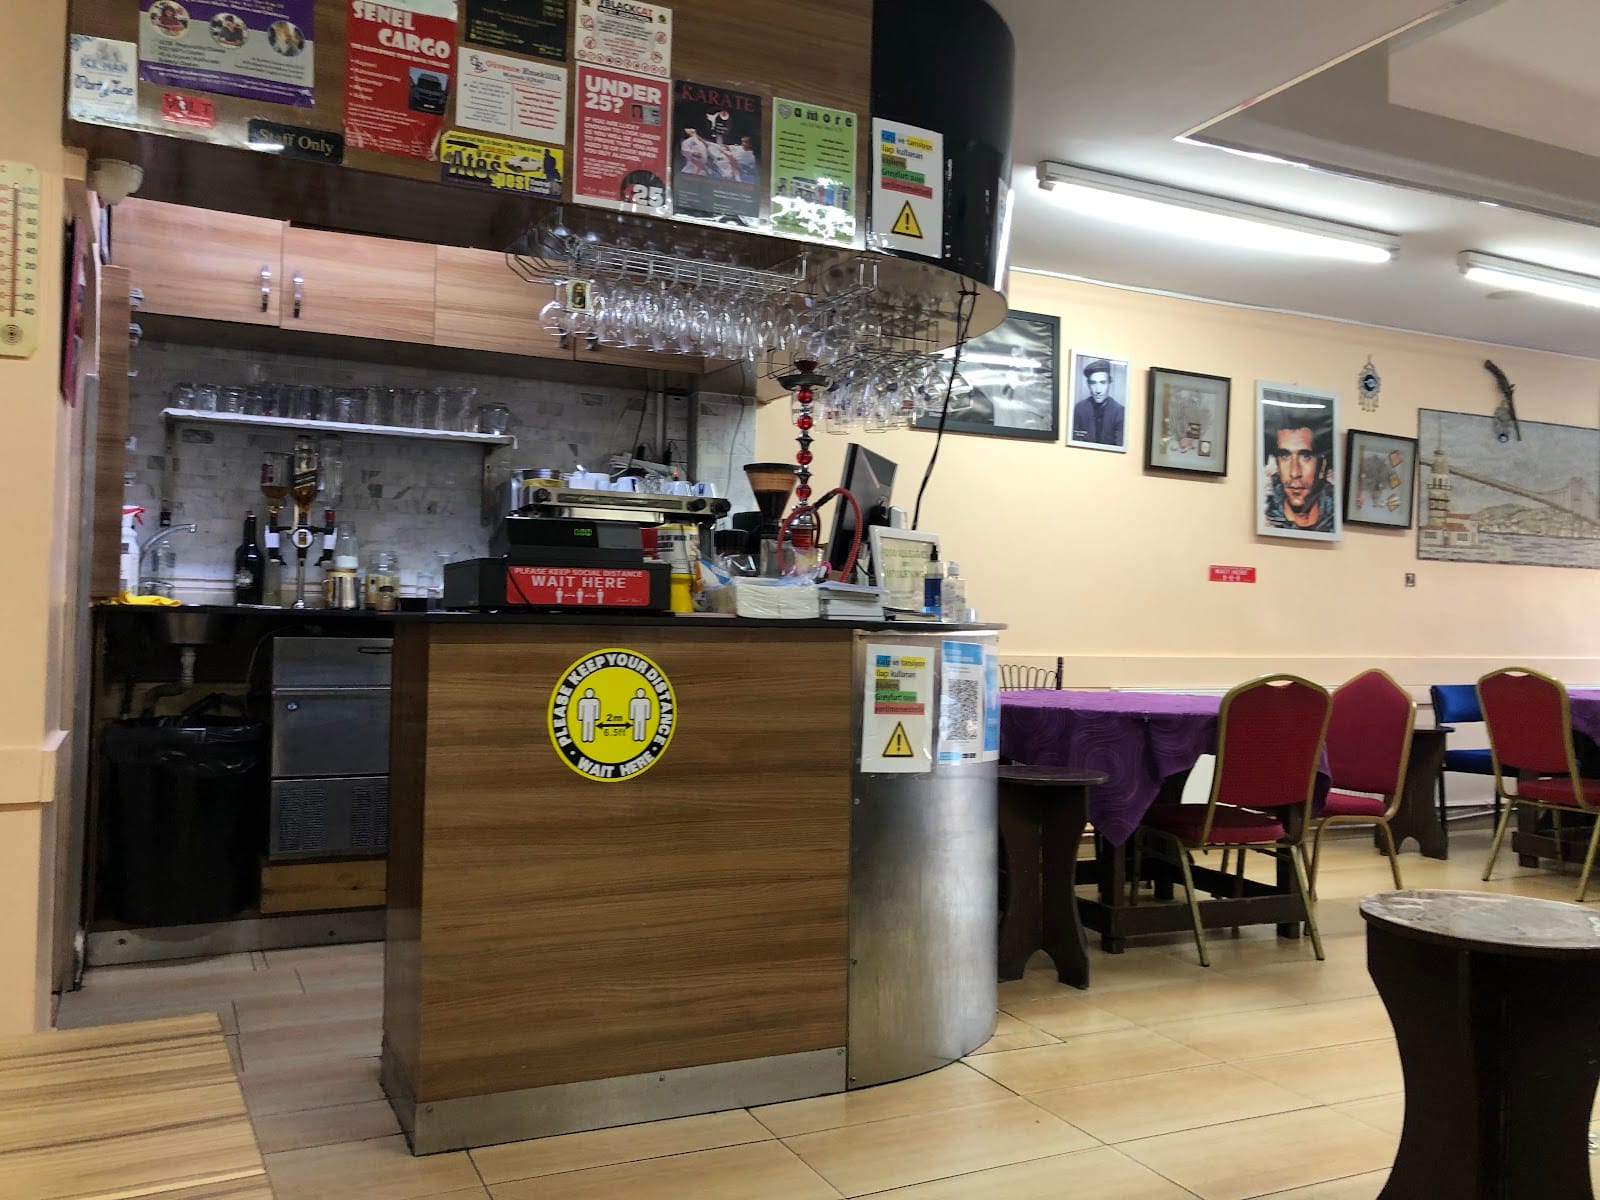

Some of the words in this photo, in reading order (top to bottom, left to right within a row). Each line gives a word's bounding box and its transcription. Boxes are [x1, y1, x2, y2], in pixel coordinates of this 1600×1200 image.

[352, 1, 415, 30] SENEL
[378, 28, 451, 59] CARGO
[585, 75, 661, 104] UNDER
[585, 92, 624, 114] 25?
[681, 86, 754, 112] KARATE
[259, 128, 296, 146] Staff
[298, 136, 334, 156] Only
[632, 184, 666, 208] 25
[514, 567, 547, 575] PLEASE
[548, 568, 571, 576] KEEP
[572, 569, 603, 577] SOCIAL
[531, 575, 577, 587] WAIT
[582, 576, 626, 588] HERE
[553, 684, 574, 748] PLEASE
[567, 655, 607, 685] KEEP
[605, 653, 649, 674] YOUR
[645, 668, 673, 746] DISTANCE
[606, 714, 623, 722] 2m
[577, 756, 615, 778] WAIT
[619, 750, 655, 777] HERE
